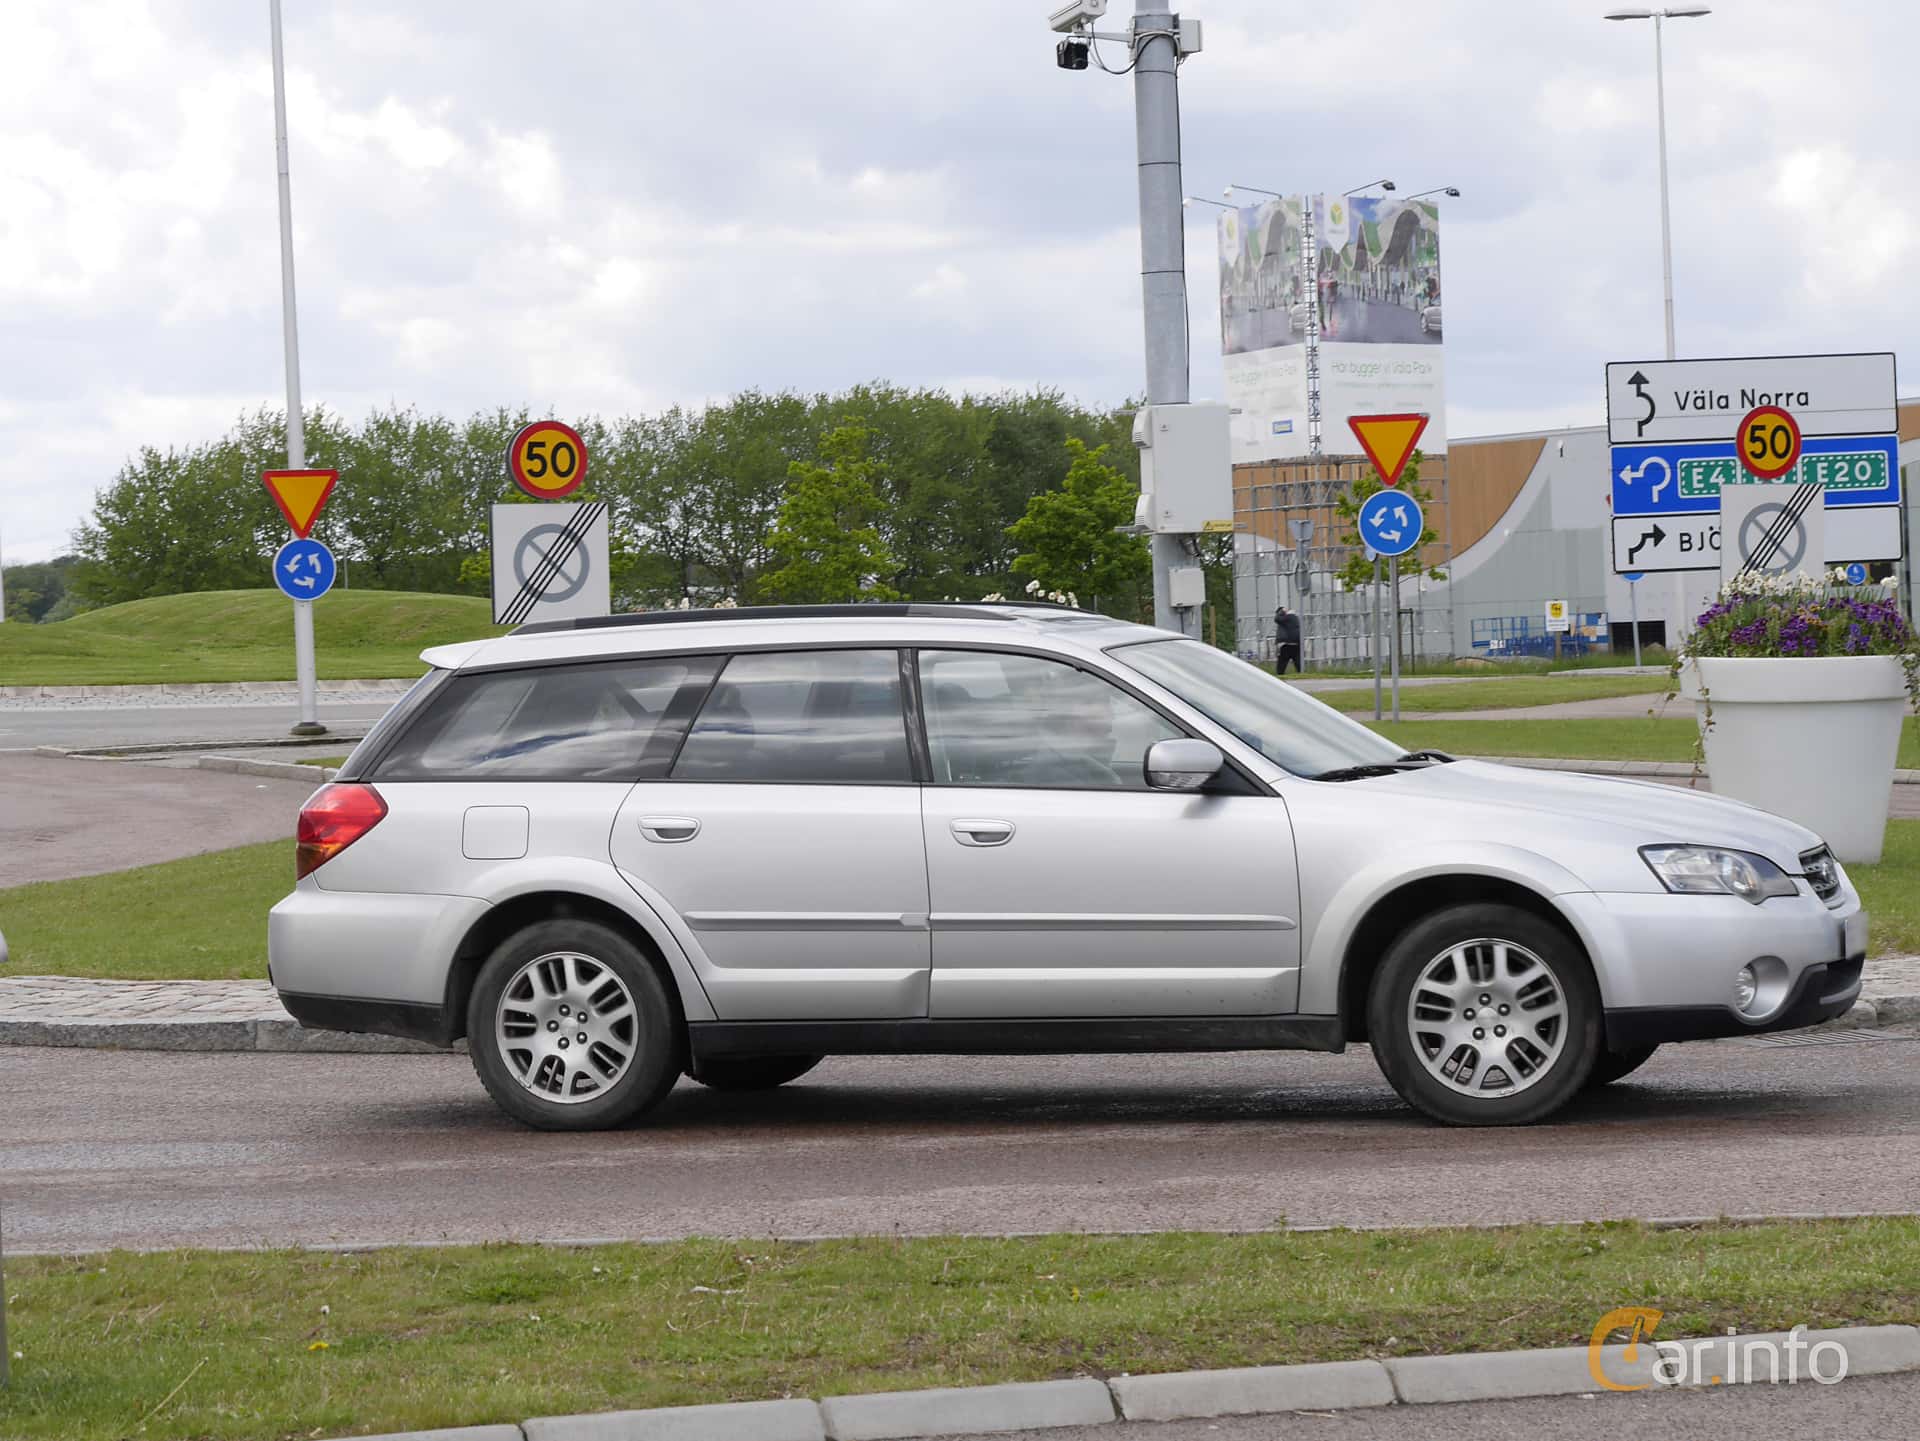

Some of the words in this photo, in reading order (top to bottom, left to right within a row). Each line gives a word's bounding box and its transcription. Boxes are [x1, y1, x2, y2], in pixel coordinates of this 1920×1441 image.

[1674, 390, 1729, 411] Väla
[1740, 388, 1809, 409] Norra
[1749, 425, 1792, 459] 50
[526, 441, 576, 478] 50
[1816, 460, 1872, 483] E20
[1692, 467, 1726, 489] E4
[1680, 525, 1721, 552] BJÖ
